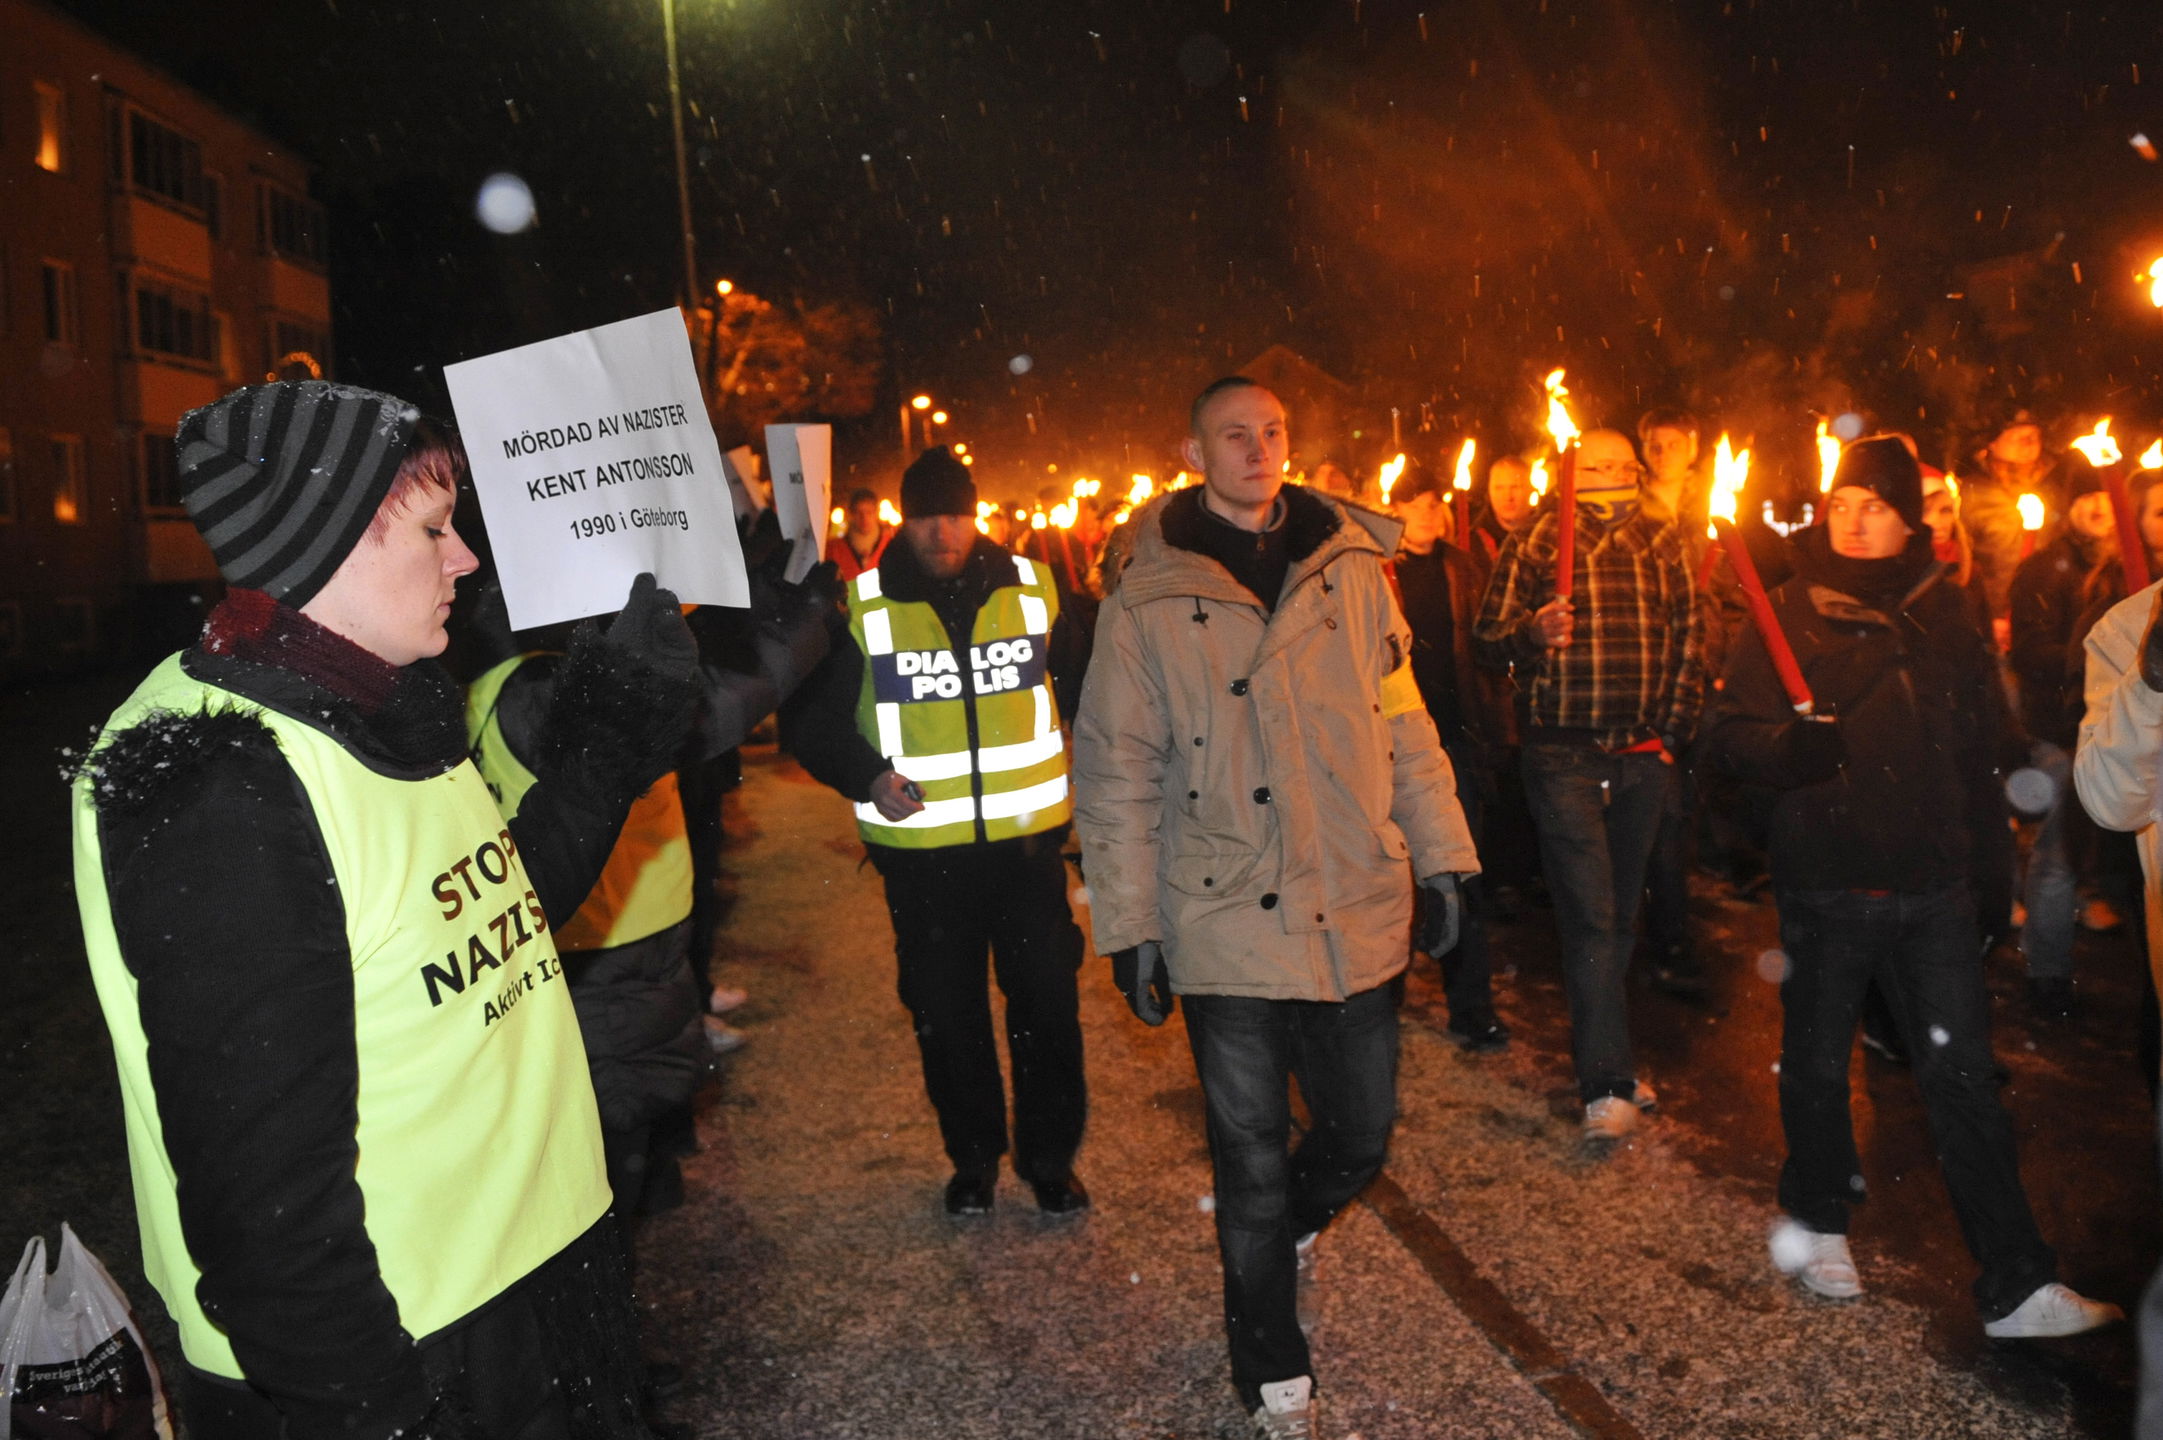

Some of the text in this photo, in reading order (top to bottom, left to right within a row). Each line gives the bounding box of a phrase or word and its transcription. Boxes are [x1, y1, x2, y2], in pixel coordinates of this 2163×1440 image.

[503, 403, 688, 459] MÖRDAD AV NAZISTER
[527, 452, 694, 501] KENT ANTONSSON
[570, 507, 689, 540] 1990 i Göteborg
[896, 639, 1033, 675] DIALOG
[912, 665, 1020, 700] POLIS
[432, 829, 516, 921] STOP
[483, 970, 535, 1027] Aktivt
